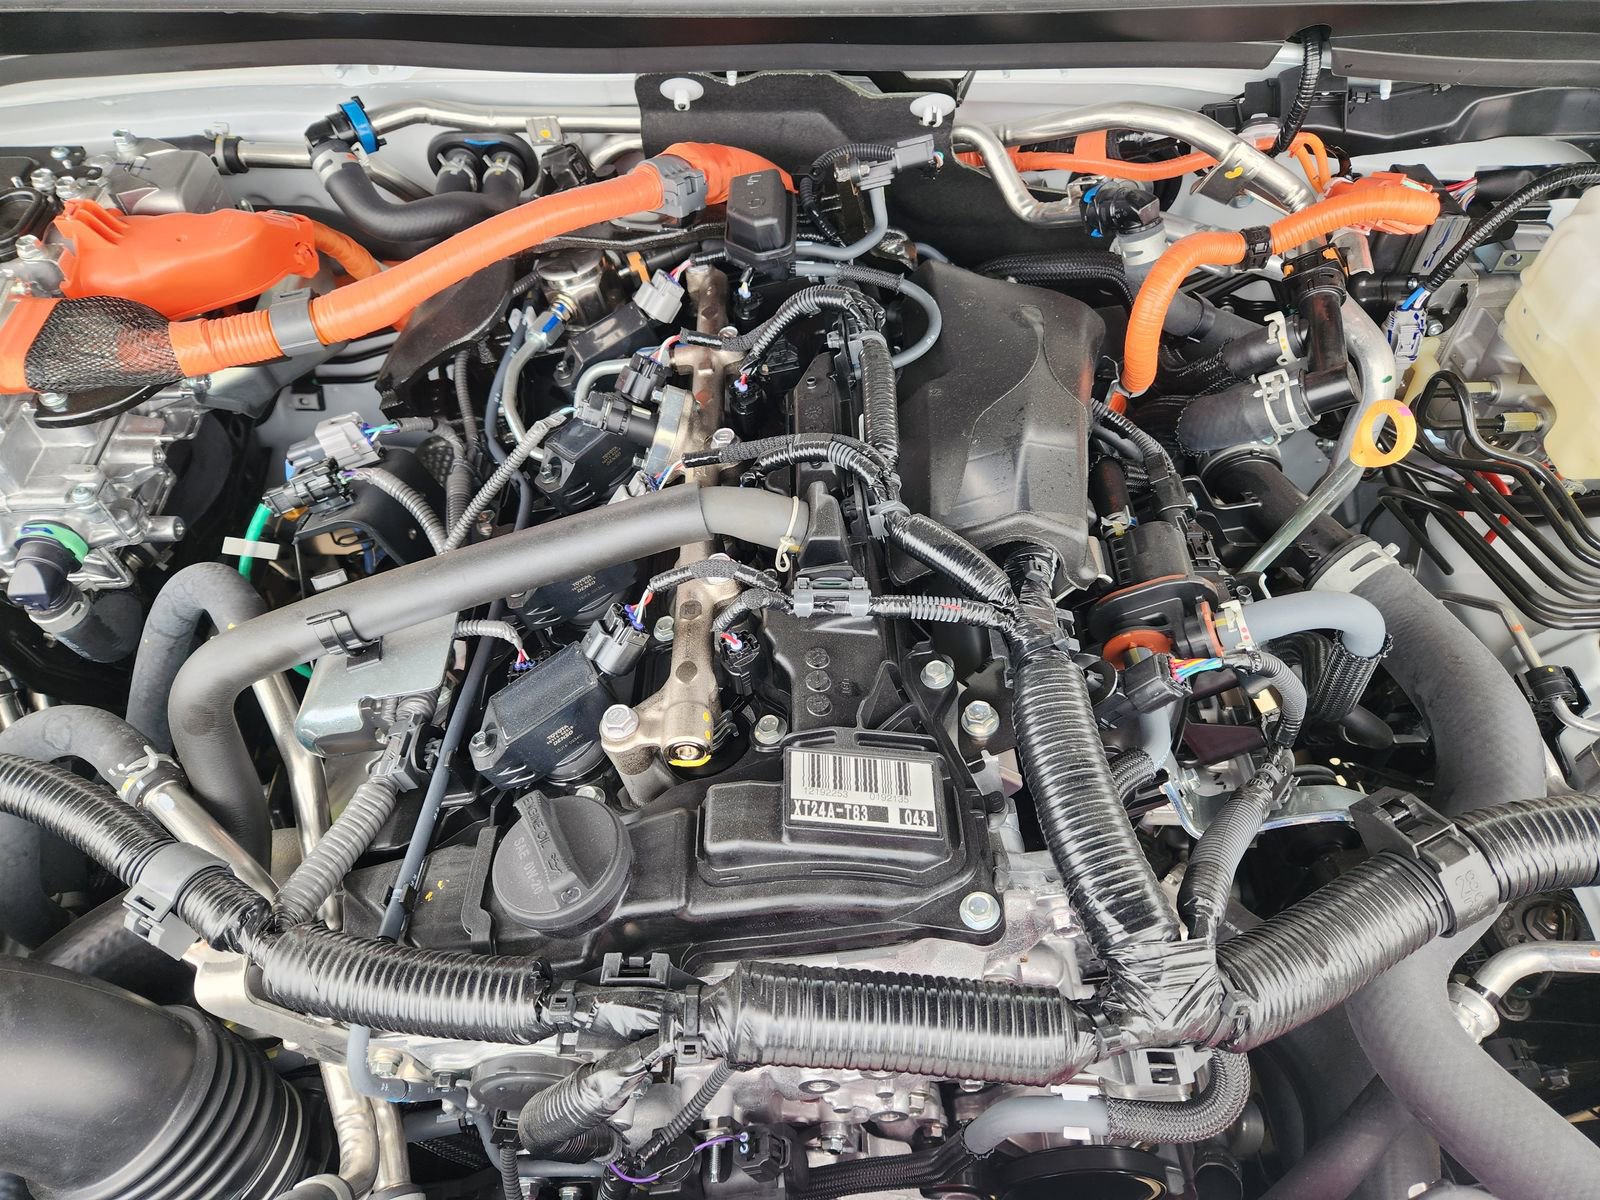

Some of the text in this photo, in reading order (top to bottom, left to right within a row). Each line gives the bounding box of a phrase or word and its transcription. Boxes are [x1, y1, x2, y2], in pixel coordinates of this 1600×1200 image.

[572, 574, 592, 587] TOYOTA
[577, 580, 596, 593] DENSO
[547, 725, 570, 740] TOYOTA
[553, 730, 574, 746] DENSO
[793, 800, 928, 826] XT24A-T83 043
[522, 796, 550, 850] ENGINE OIL
[514, 837, 544, 895] SAE 0W-20
